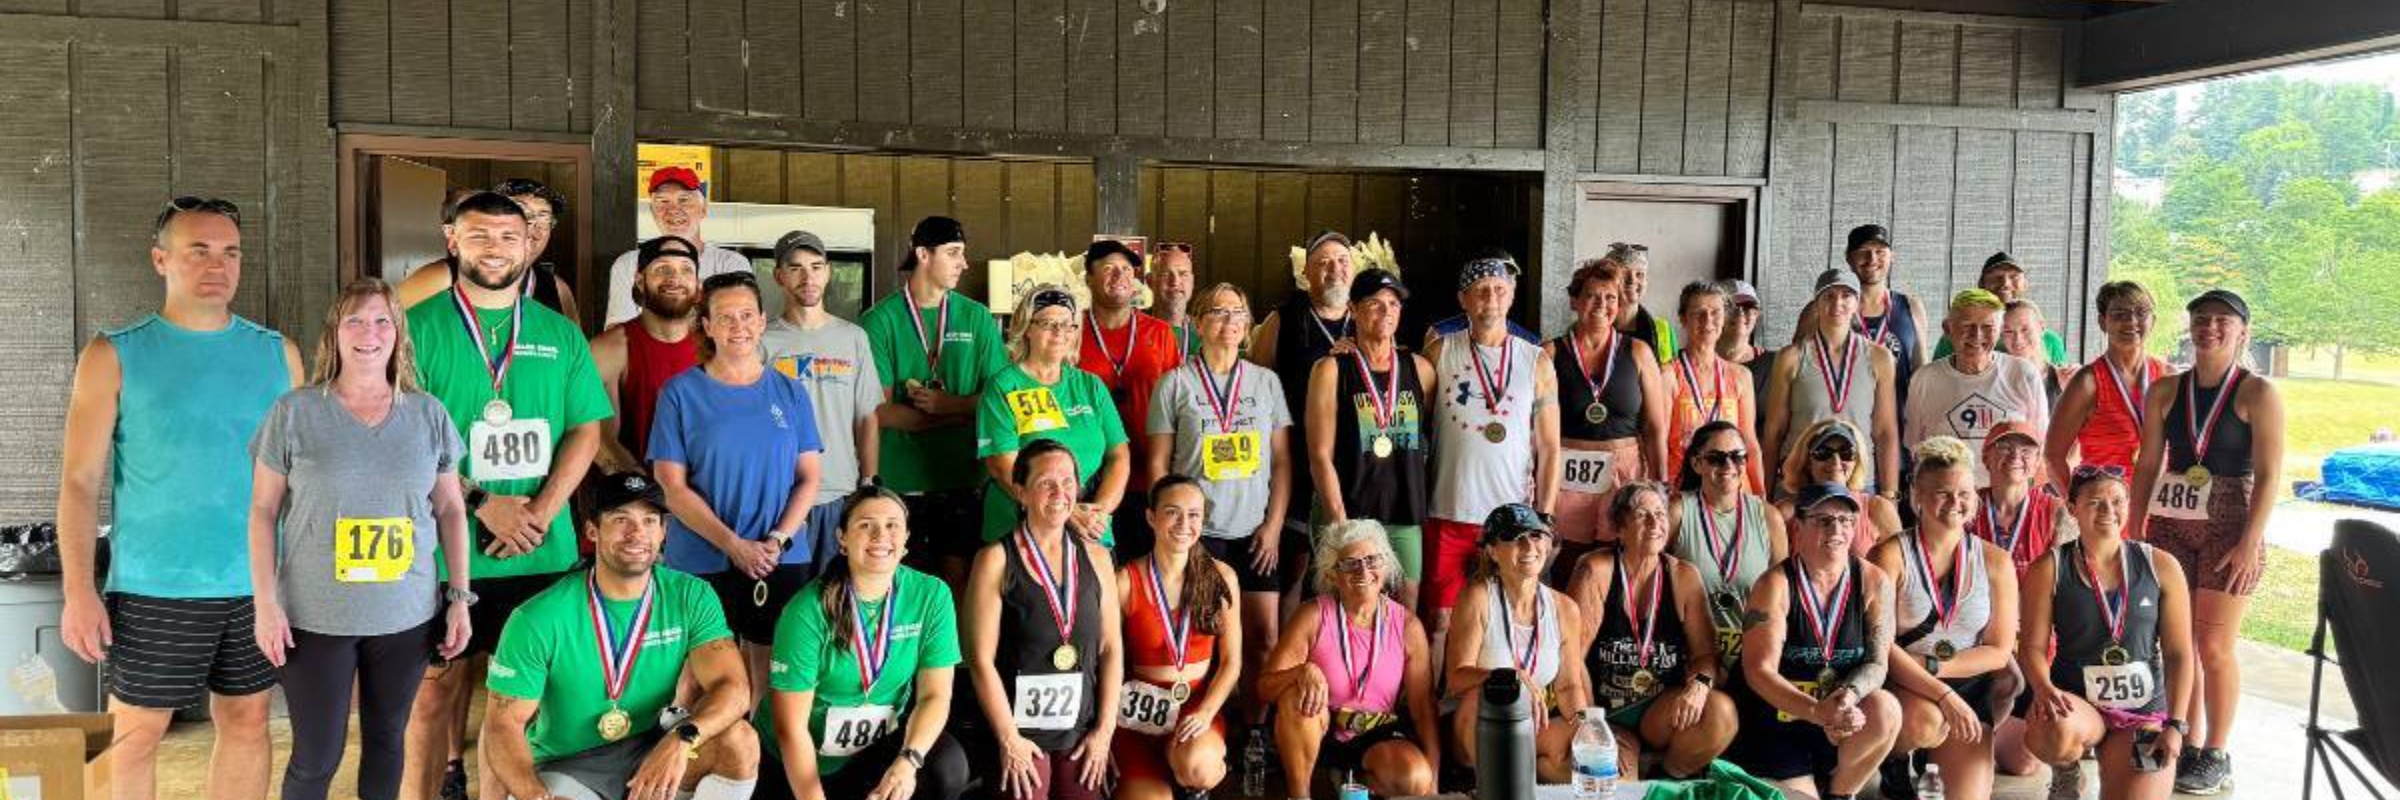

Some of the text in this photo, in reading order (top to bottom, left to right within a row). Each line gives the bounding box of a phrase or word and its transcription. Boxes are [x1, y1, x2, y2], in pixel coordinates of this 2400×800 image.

[1016, 391, 1059, 416] 514
[484, 430, 540, 466] 480
[1565, 458, 1605, 483] 687
[2157, 482, 2200, 510] 486
[349, 525, 404, 560] 176
[1026, 685, 1075, 718] 322
[2095, 674, 2145, 701] 259
[1122, 691, 1171, 727] 398
[835, 718, 888, 748] 484
